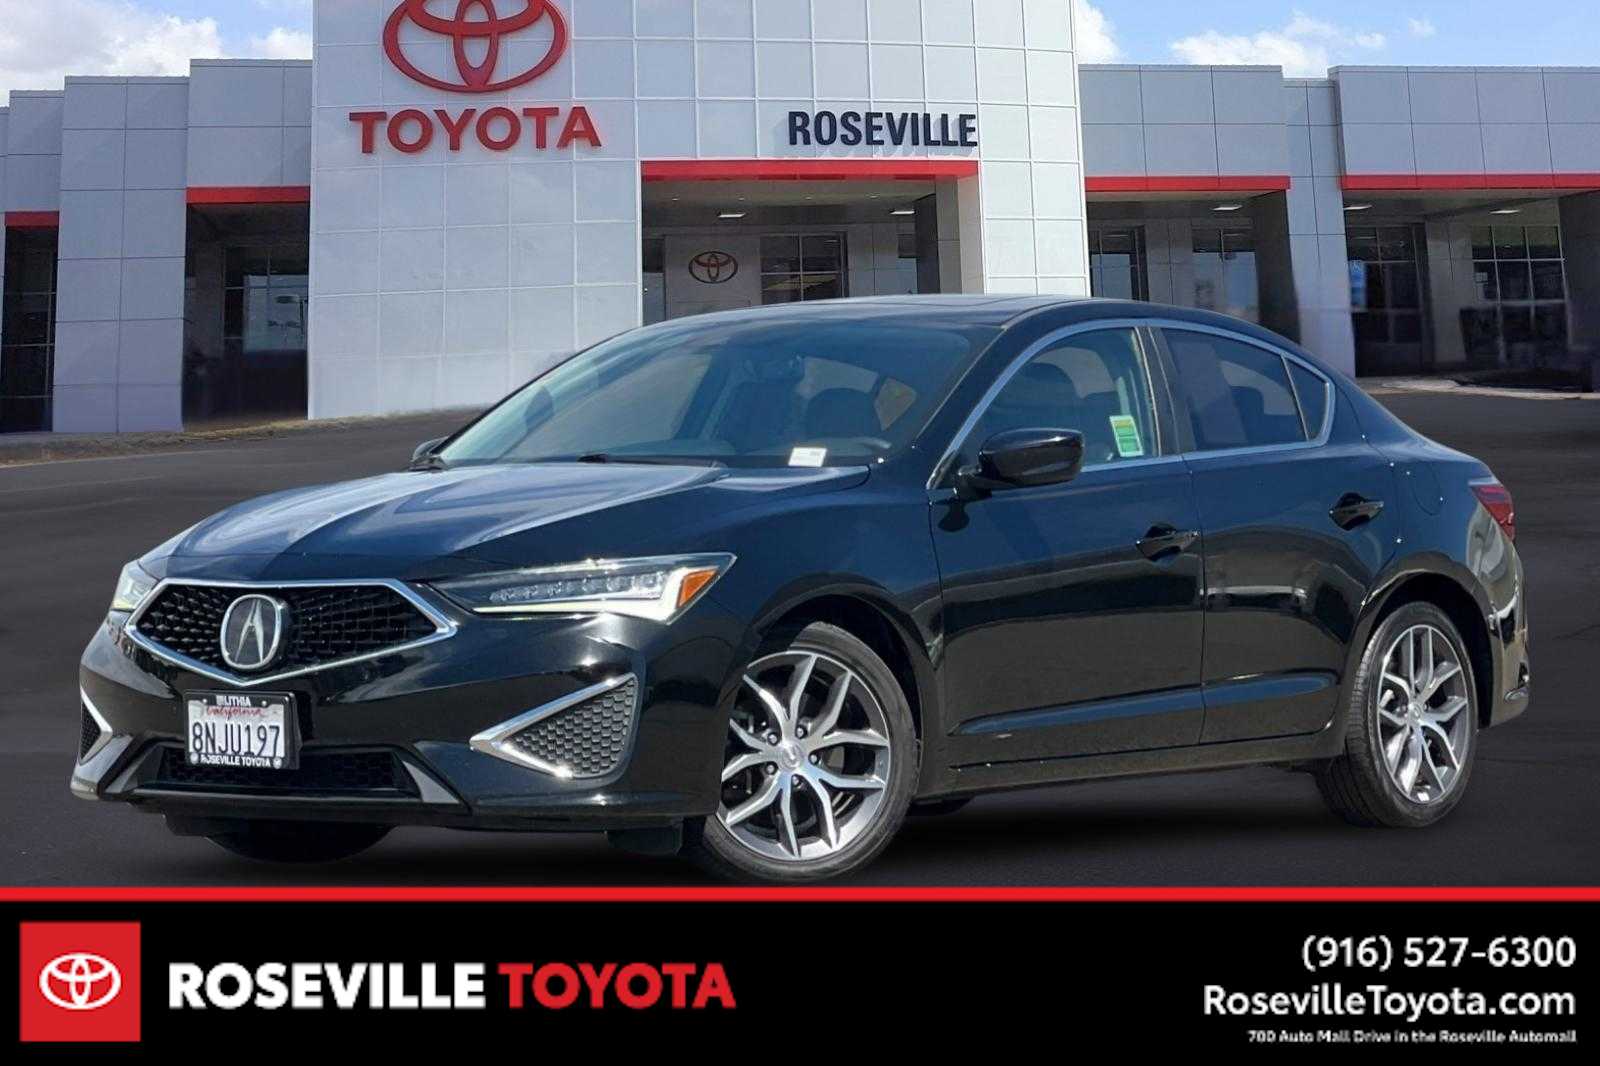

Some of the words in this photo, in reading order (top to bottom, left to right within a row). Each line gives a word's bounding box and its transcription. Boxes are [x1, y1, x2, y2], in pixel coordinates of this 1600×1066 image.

[349, 106, 602, 153] TOYOTA
[788, 111, 978, 147] ROSEVILLE
[192, 721, 280, 759] 8NJU197
[200, 753, 240, 766] ROSEVILLE
[241, 756, 271, 768] TOYOTA
